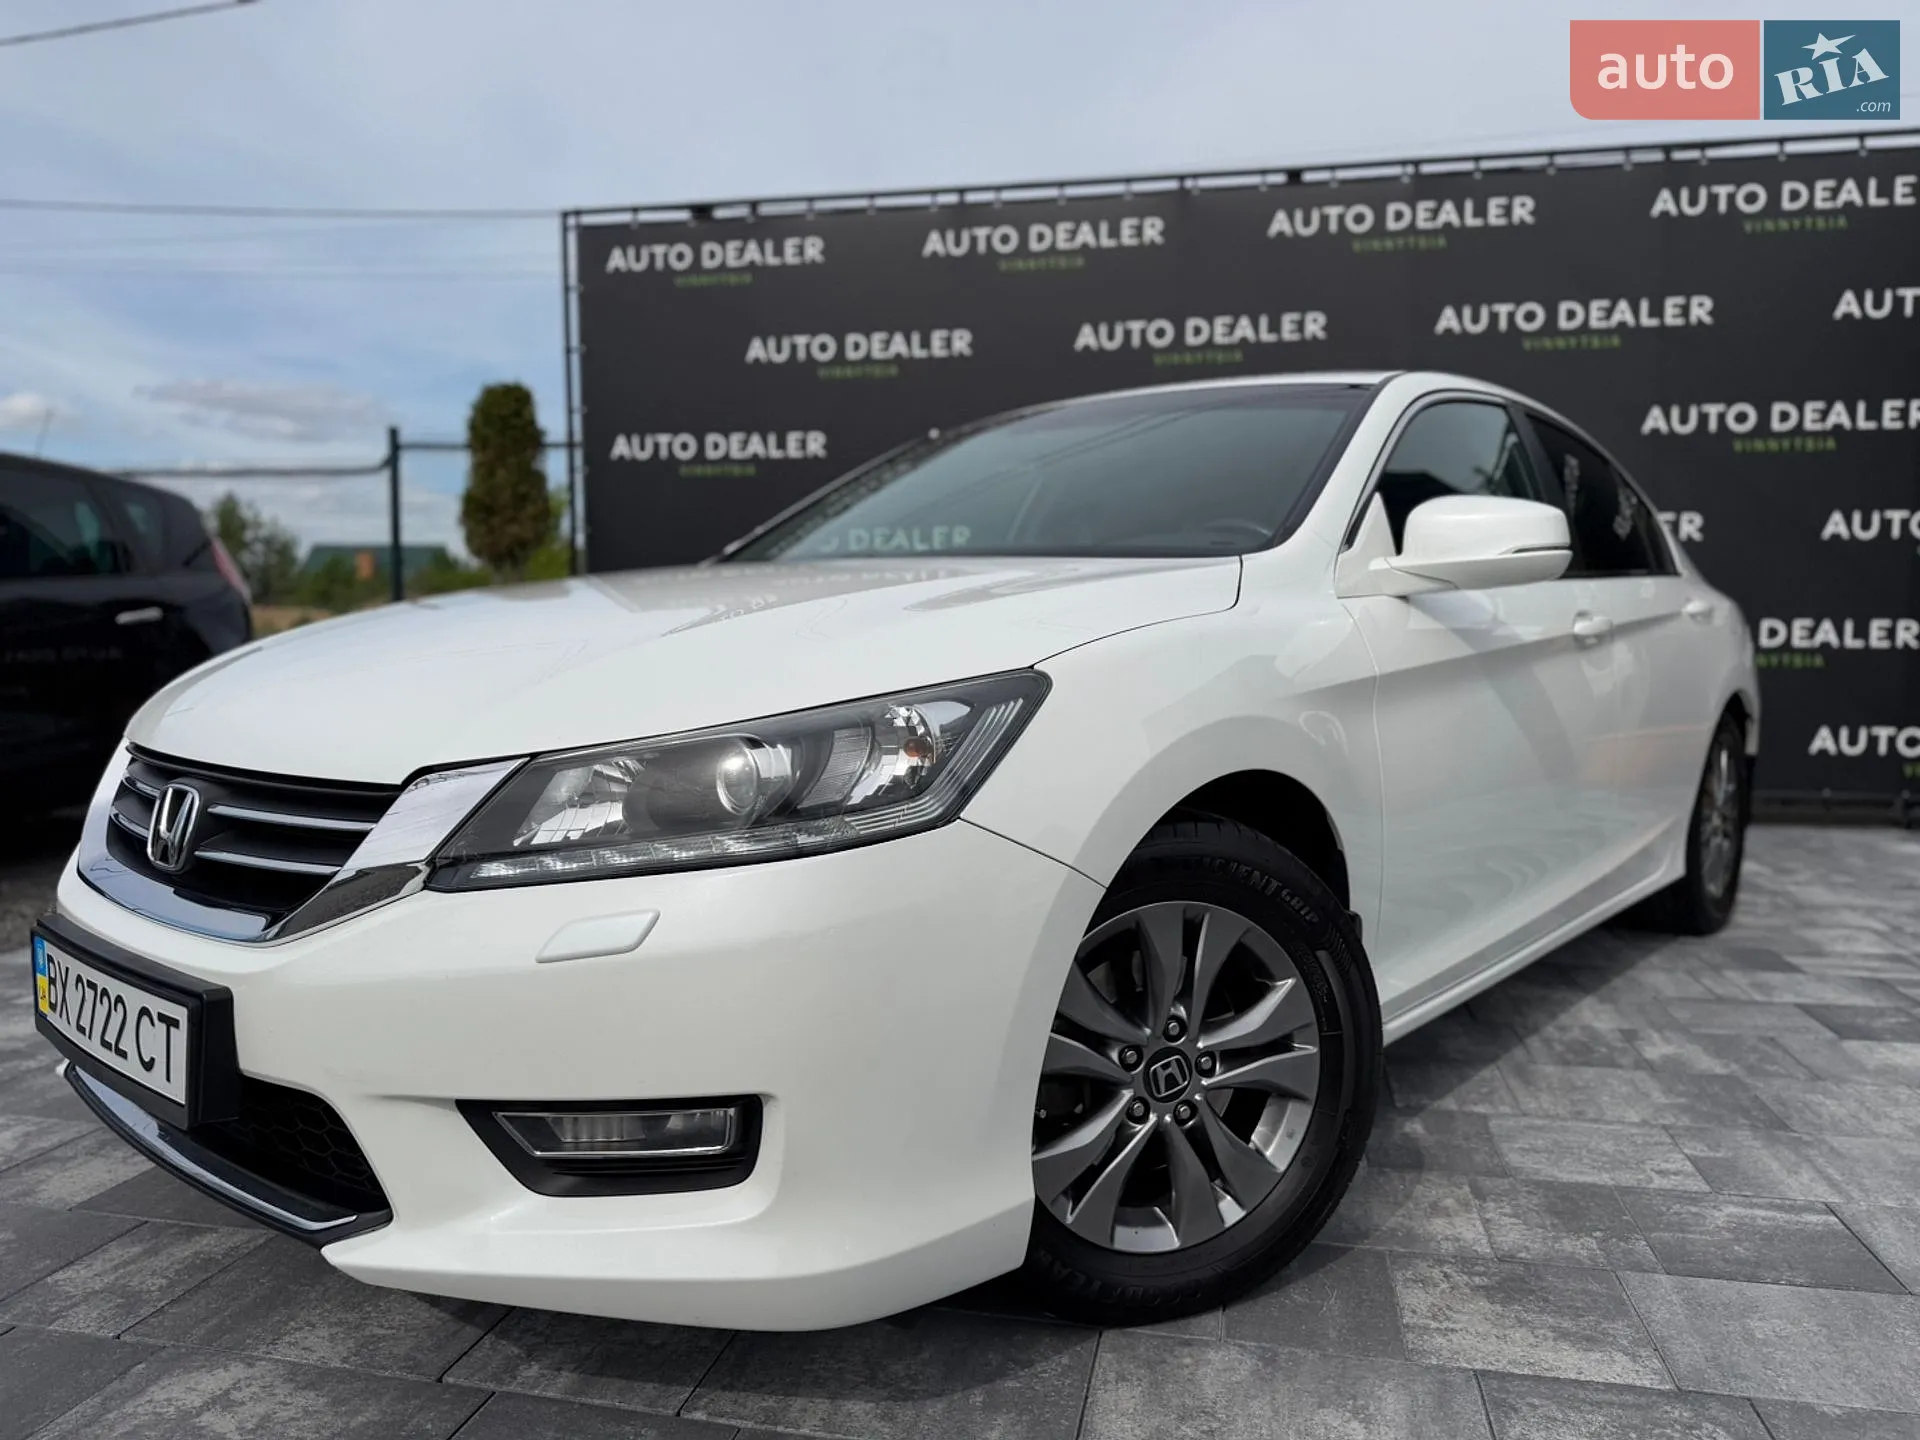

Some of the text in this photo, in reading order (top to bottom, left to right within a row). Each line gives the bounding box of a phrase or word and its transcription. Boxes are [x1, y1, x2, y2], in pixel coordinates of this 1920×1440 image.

[1268, 196, 1535, 237] AUTO DEALER
[1650, 183, 1767, 217] AUTO
[606, 236, 824, 272] AUTO DEALER
[922, 217, 1164, 257] AUTO DEALER
[1074, 311, 1326, 351] AUTO DEALER
[1435, 295, 1713, 334] AUTO DEALER
[746, 329, 972, 363] AUTO DEALER
[1641, 402, 1757, 434] AUTO
[611, 431, 826, 460] AUTO DEALER
[849, 525, 972, 552] DEALER
[1759, 618, 1920, 649] DEALER
[1809, 726, 1920, 757] AUTO
[47, 953, 181, 1084] BX 2722 CT
